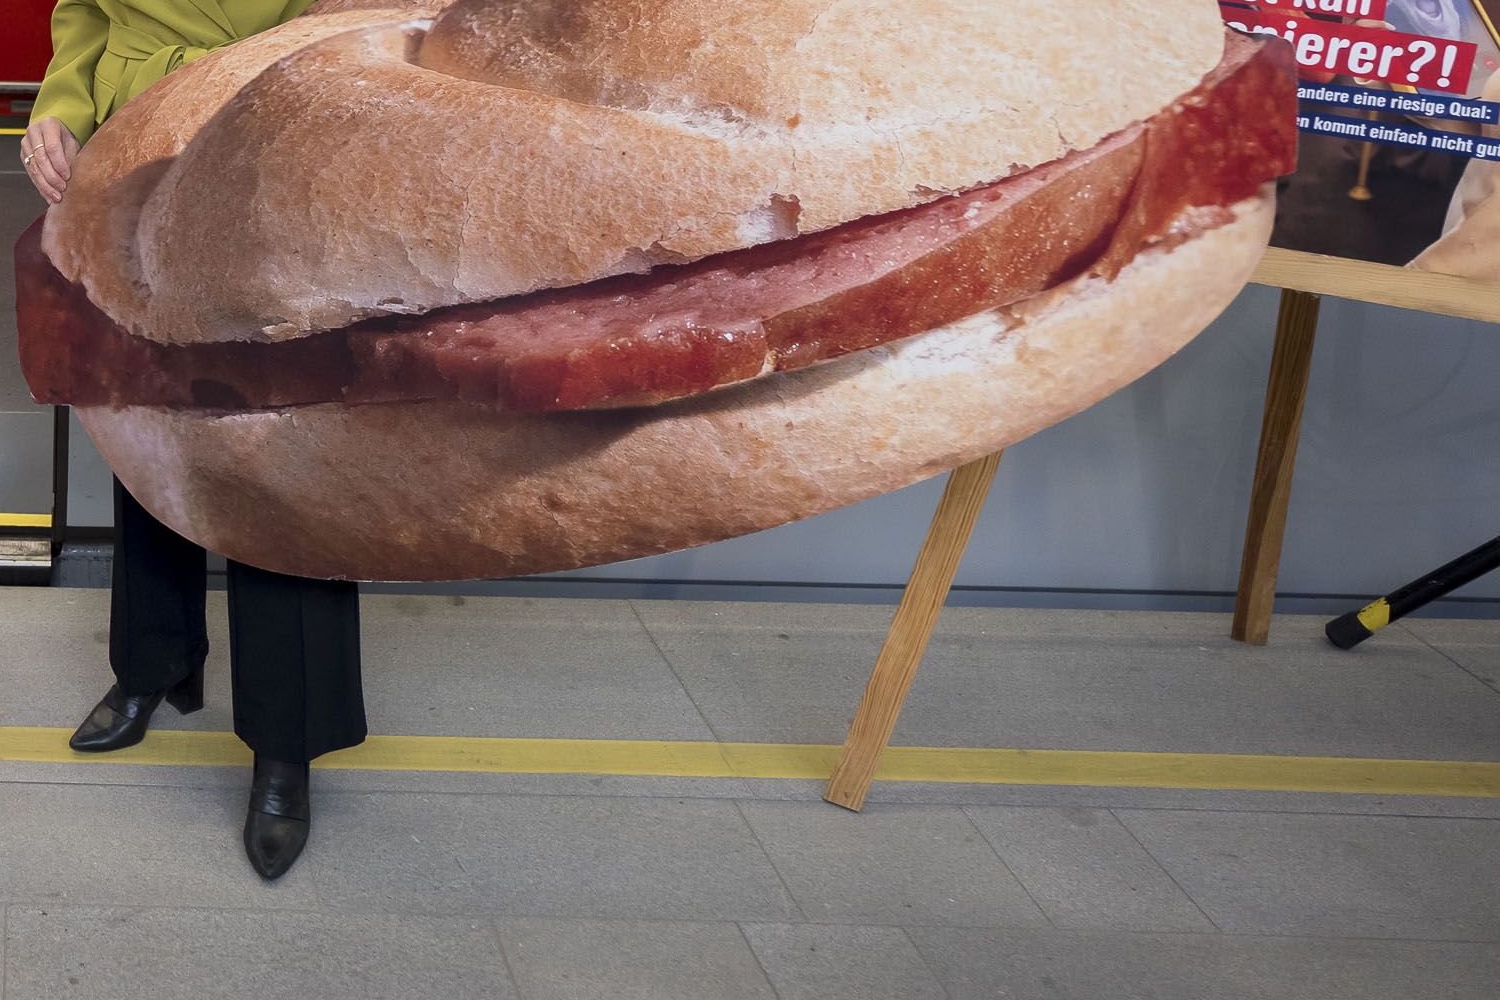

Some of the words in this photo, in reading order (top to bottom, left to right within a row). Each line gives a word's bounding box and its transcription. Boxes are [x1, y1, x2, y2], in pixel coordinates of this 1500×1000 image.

[1297, 87, 1350, 103] andere
[1353, 92, 1387, 108] eine
[1390, 96, 1446, 117] riesige
[1449, 101, 1492, 120] Qual:
[1313, 116, 1367, 137] kommt
[1369, 126, 1428, 146] einfach
[1431, 135, 1474, 153] nicht
